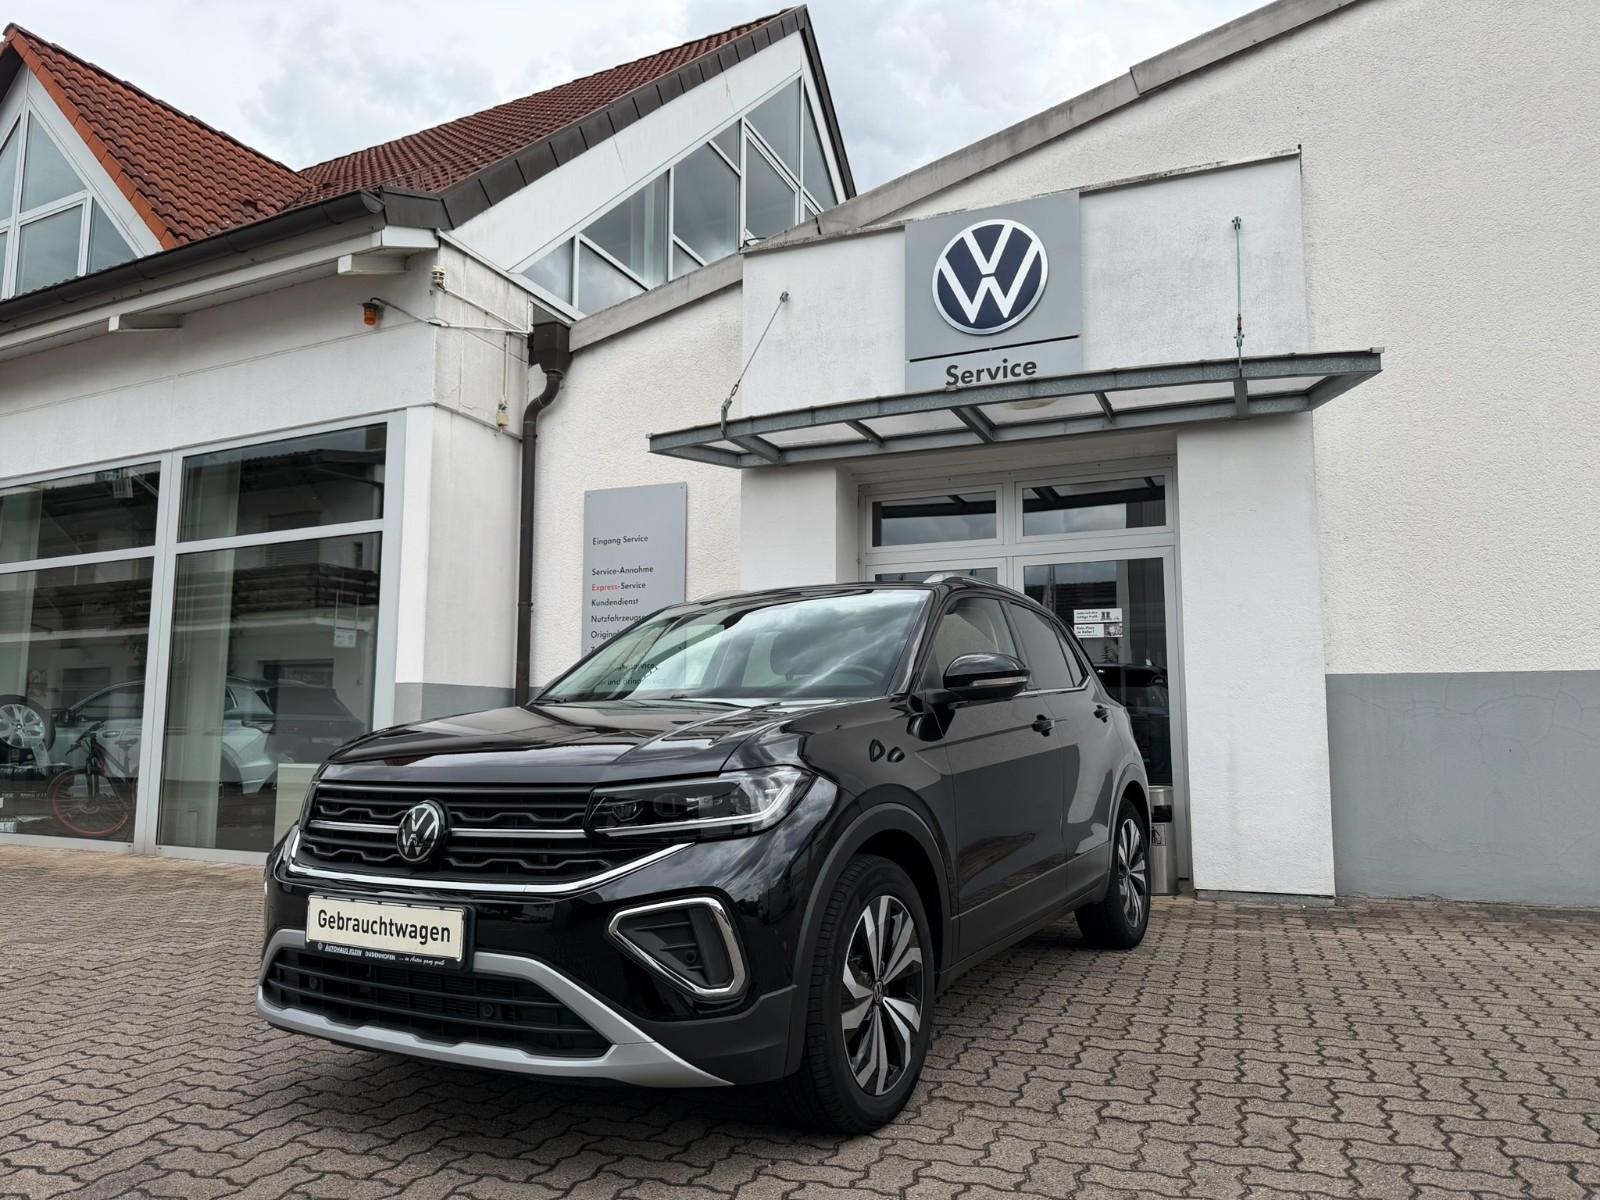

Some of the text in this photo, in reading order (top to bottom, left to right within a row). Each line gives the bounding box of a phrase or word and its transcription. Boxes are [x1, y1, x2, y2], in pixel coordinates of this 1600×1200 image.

[945, 358, 1037, 386] Service
[592, 535, 648, 546] Eingang Service
[591, 565, 654, 576] Service-Annahme
[591, 582, 646, 592] Express-Service
[591, 598, 639, 607] Kundendienst
[317, 909, 451, 945] Gebrauchtwagen
[324, 943, 349, 954] AUTOHAUS
[348, 948, 363, 957] KLEIN
